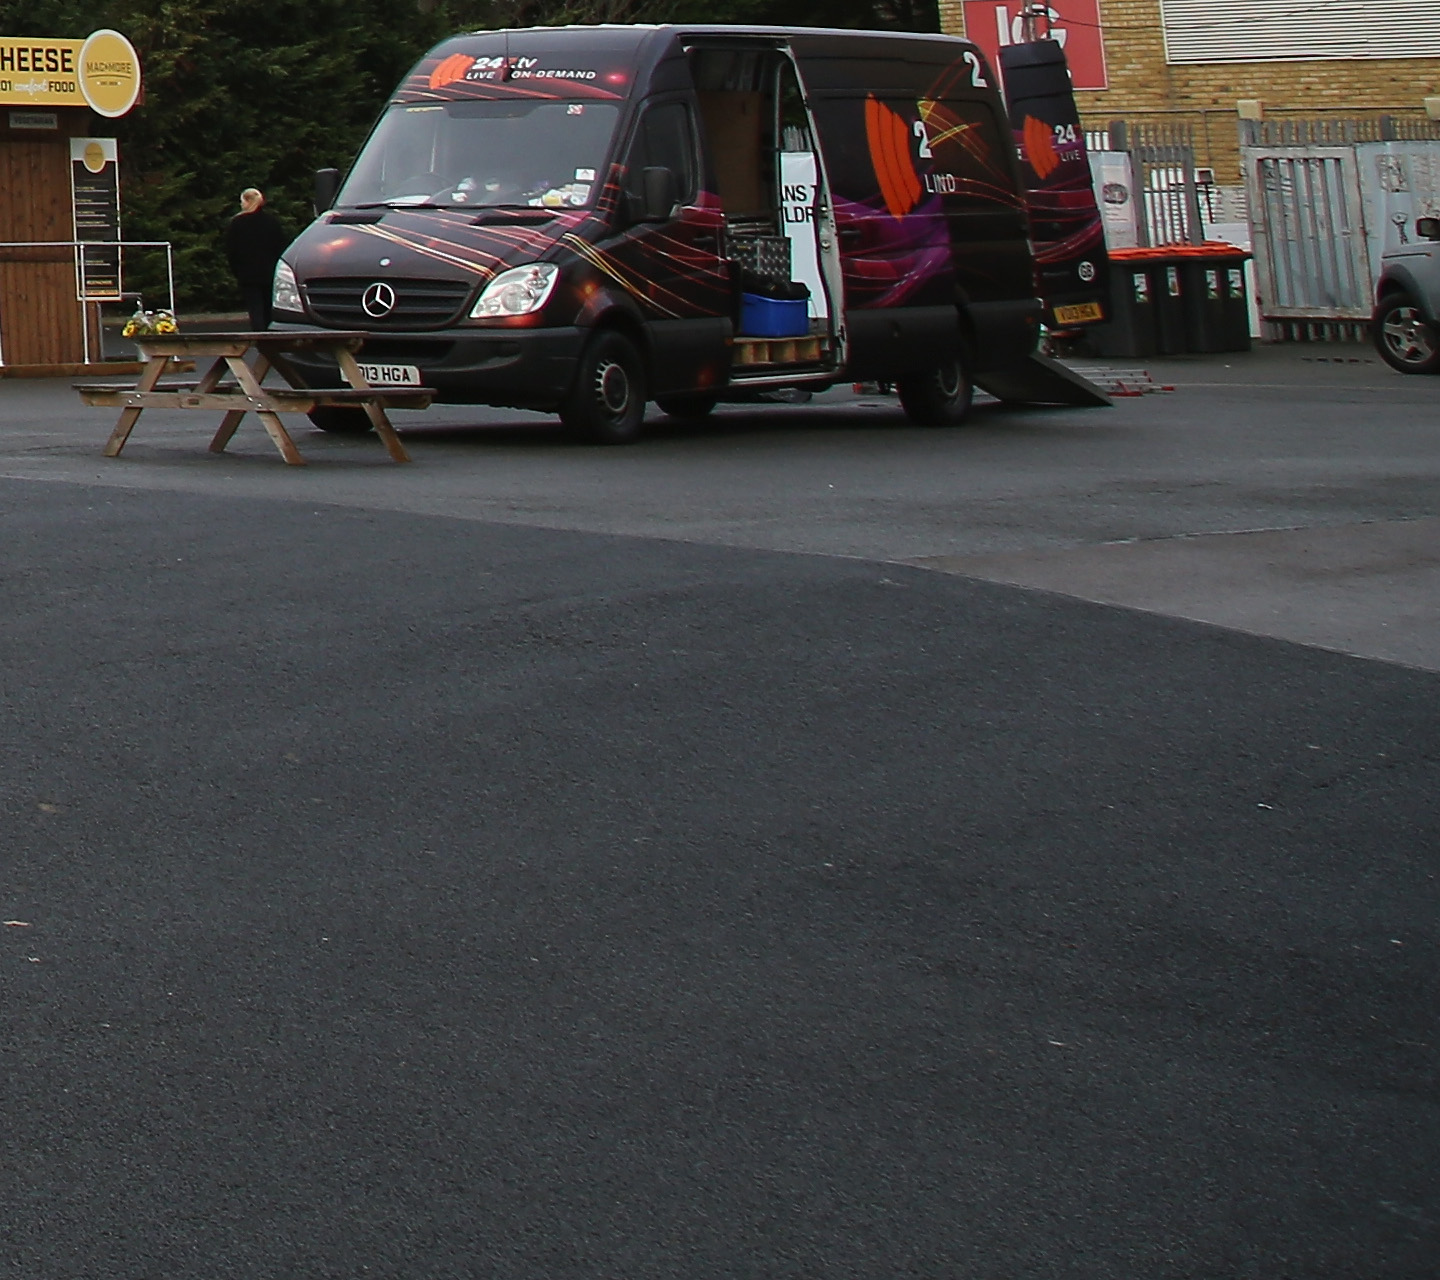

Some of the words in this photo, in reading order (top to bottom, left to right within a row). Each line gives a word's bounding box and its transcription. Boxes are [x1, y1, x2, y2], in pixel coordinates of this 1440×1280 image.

[466, 71, 496, 80] LIVE
[511, 71, 531, 79] ON
[536, 70, 597, 80] DEMAND
[48, 81, 76, 93] FOOD
[1055, 124, 1076, 144] 24
[1081, 265, 1093, 278] GB
[382, 366, 412, 383] HGA
